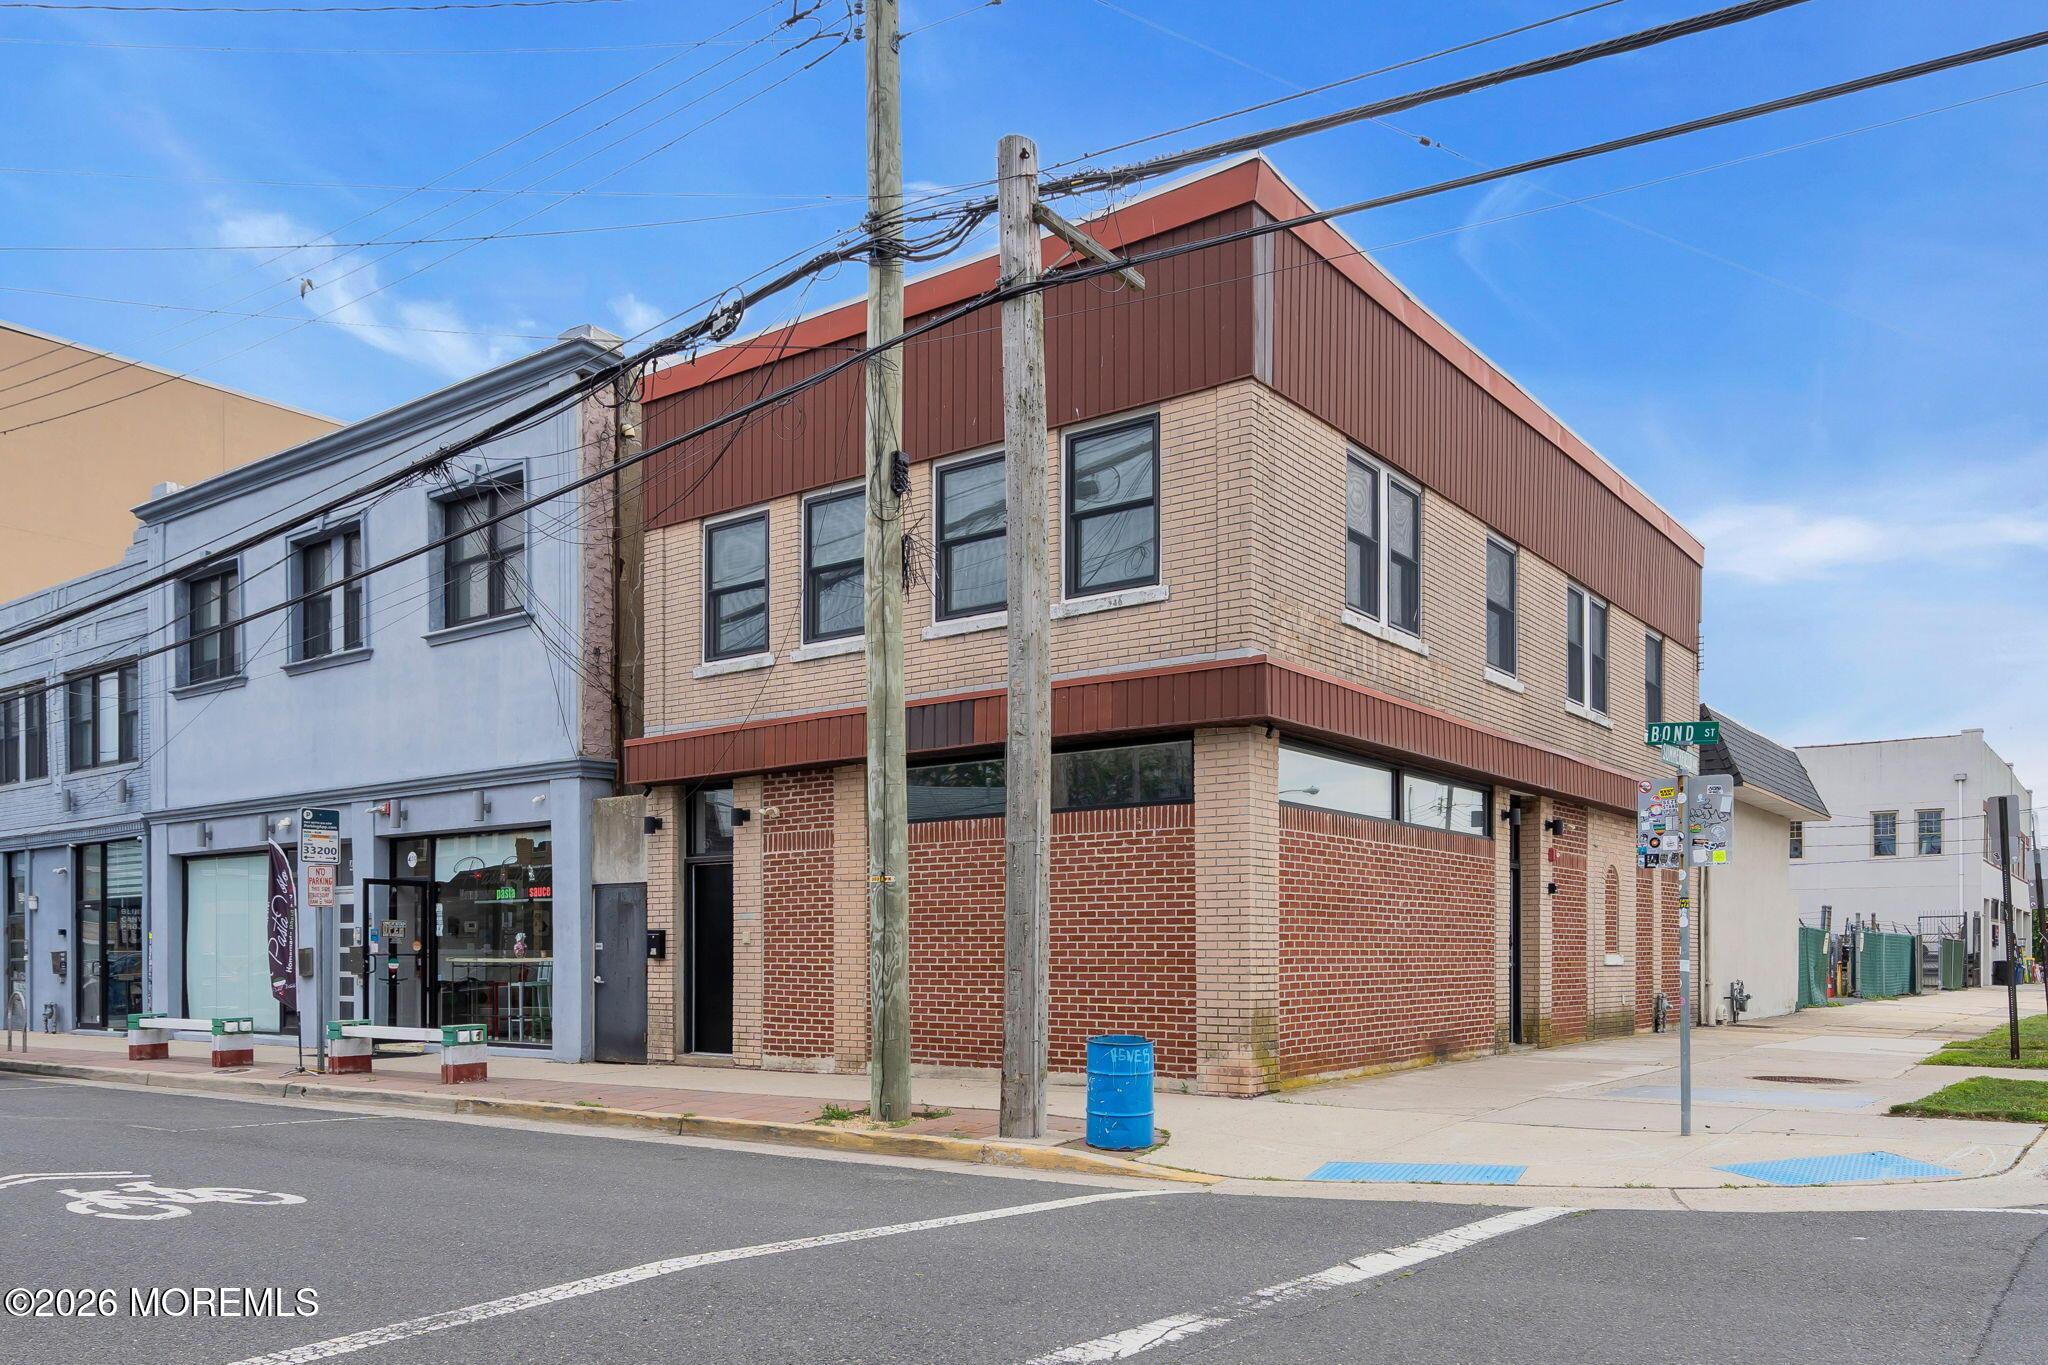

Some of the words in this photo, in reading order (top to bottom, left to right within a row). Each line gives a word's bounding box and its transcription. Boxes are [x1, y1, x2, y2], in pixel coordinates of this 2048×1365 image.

[1651, 725, 1694, 742] BOND
[1704, 728, 1716, 738] ST
[303, 845, 338, 856] 33200
[315, 867, 326, 876] NO
[308, 877, 333, 885] PARKING
[496, 887, 516, 900] pasta
[528, 886, 551, 897] sauce
[268, 916, 289, 965] Pasta
